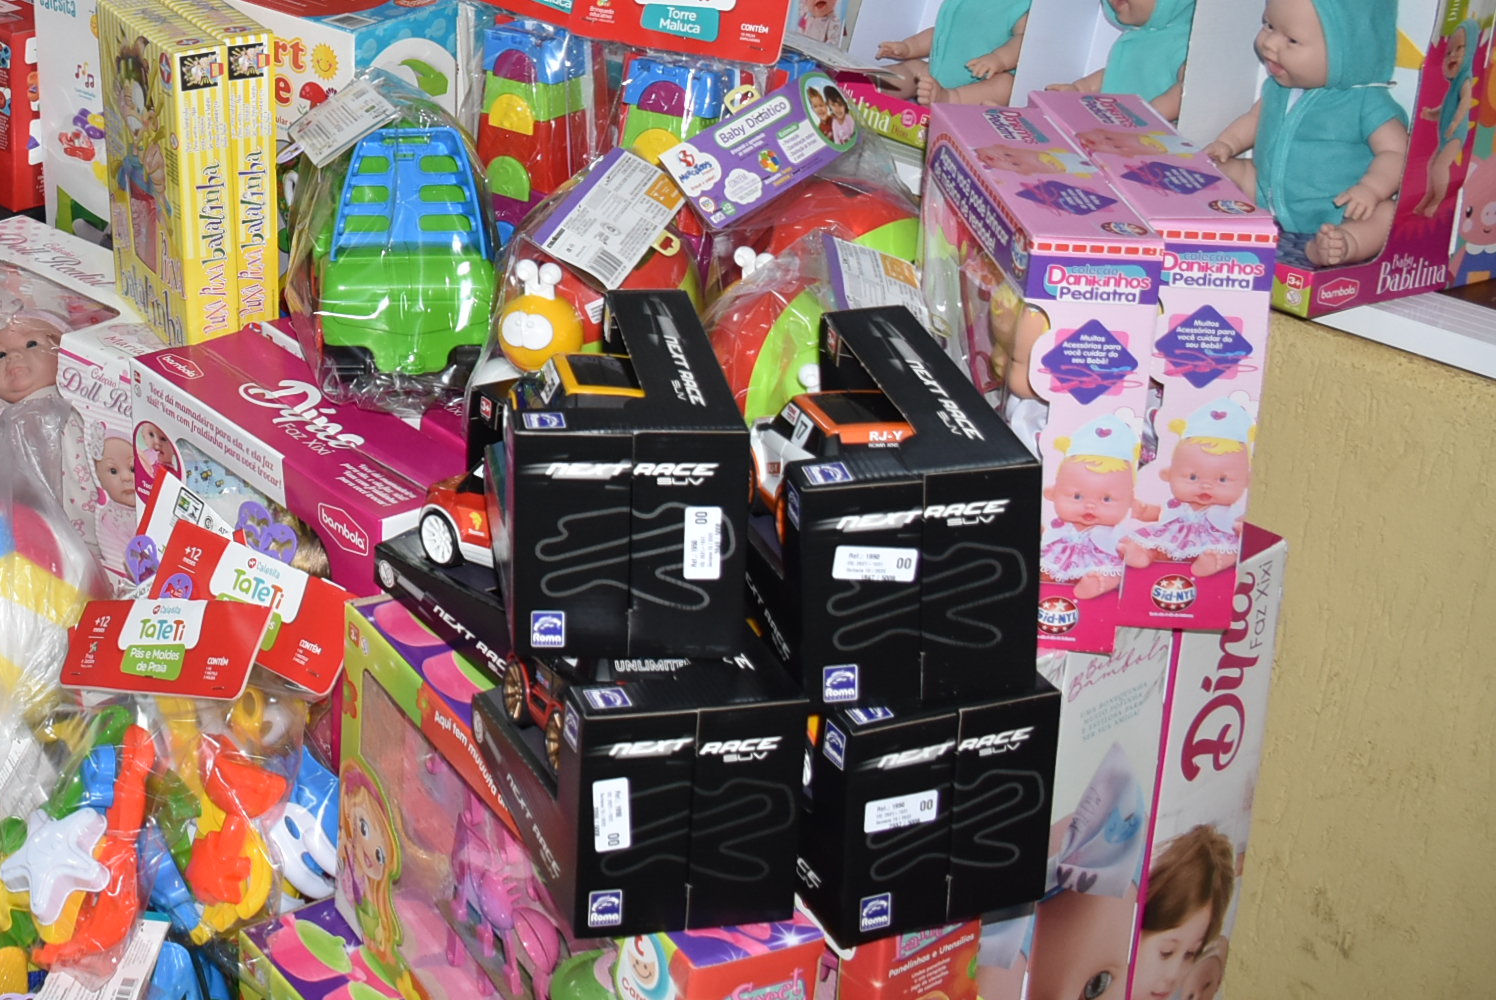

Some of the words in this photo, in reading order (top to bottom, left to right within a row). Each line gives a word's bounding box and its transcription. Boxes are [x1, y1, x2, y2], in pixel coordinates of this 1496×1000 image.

[666, 6, 698, 23] Torre
[658, 17, 702, 35] Maluca
[739, 22, 770, 35] CONTÉM
[717, 123, 746, 146] Baby
[745, 100, 789, 129] Didático
[1161, 250, 1266, 279] Danikinhos
[1391, 252, 1415, 271] Baby
[1045, 263, 1153, 293] Danikinhos
[1171, 272, 1252, 291] Pediatra
[1288, 274, 1304, 288] 3+
[1375, 259, 1447, 296] Babilina
[1057, 287, 1138, 305] Pediatra
[1319, 285, 1357, 303] bambola
[1175, 325, 1216, 337] Acessórios
[1217, 329, 1236, 339] para
[1193, 319, 1221, 329] Muitos
[1177, 334, 1194, 343] você
[1195, 334, 1220, 344] cuidar
[1221, 335, 1233, 344] do
[1185, 341, 1199, 350] seu
[163, 353, 201, 380] bambola
[664, 334, 691, 372] NEXT
[680, 369, 707, 408] RACE
[62, 366, 101, 402] Doll
[175, 397, 215, 429] mamadeira
[215, 420, 234, 440] para
[278, 421, 304, 443] Faz
[305, 439, 336, 458] Xixi
[868, 430, 905, 443] RJ-Y
[546, 461, 633, 479] NEXT
[632, 461, 720, 477] RACE
[656, 477, 704, 486] SUV
[835, 510, 923, 532] NEXT
[923, 499, 1010, 520] RACE
[946, 514, 997, 527] SUV
[320, 506, 367, 551] bambola
[184, 545, 204, 562] +12
[896, 557, 912, 570] 00
[232, 568, 287, 611] TaTeTi
[1255, 560, 1273, 602] Xixi
[139, 617, 187, 642] TaTeTi
[432, 604, 477, 642] NEXT
[1249, 605, 1268, 652] Faz
[531, 631, 563, 644] Roma
[129, 647, 146, 660] Pás
[152, 648, 181, 662] Moldes
[206, 656, 230, 667] CONTÉM
[136, 662, 148, 672] de
[148, 662, 168, 674] Praia
[1181, 571, 1260, 783] Dina
[824, 687, 857, 699] Roma
[433, 709, 454, 733] Aqui
[451, 722, 469, 746] tem
[609, 737, 694, 759] NEXT
[699, 735, 783, 756] RACE
[877, 740, 956, 770] NEXT
[957, 727, 1035, 752] RACE
[978, 741, 1021, 757] SUV
[722, 751, 769, 764] SUV
[590, 912, 621, 924] Roma
